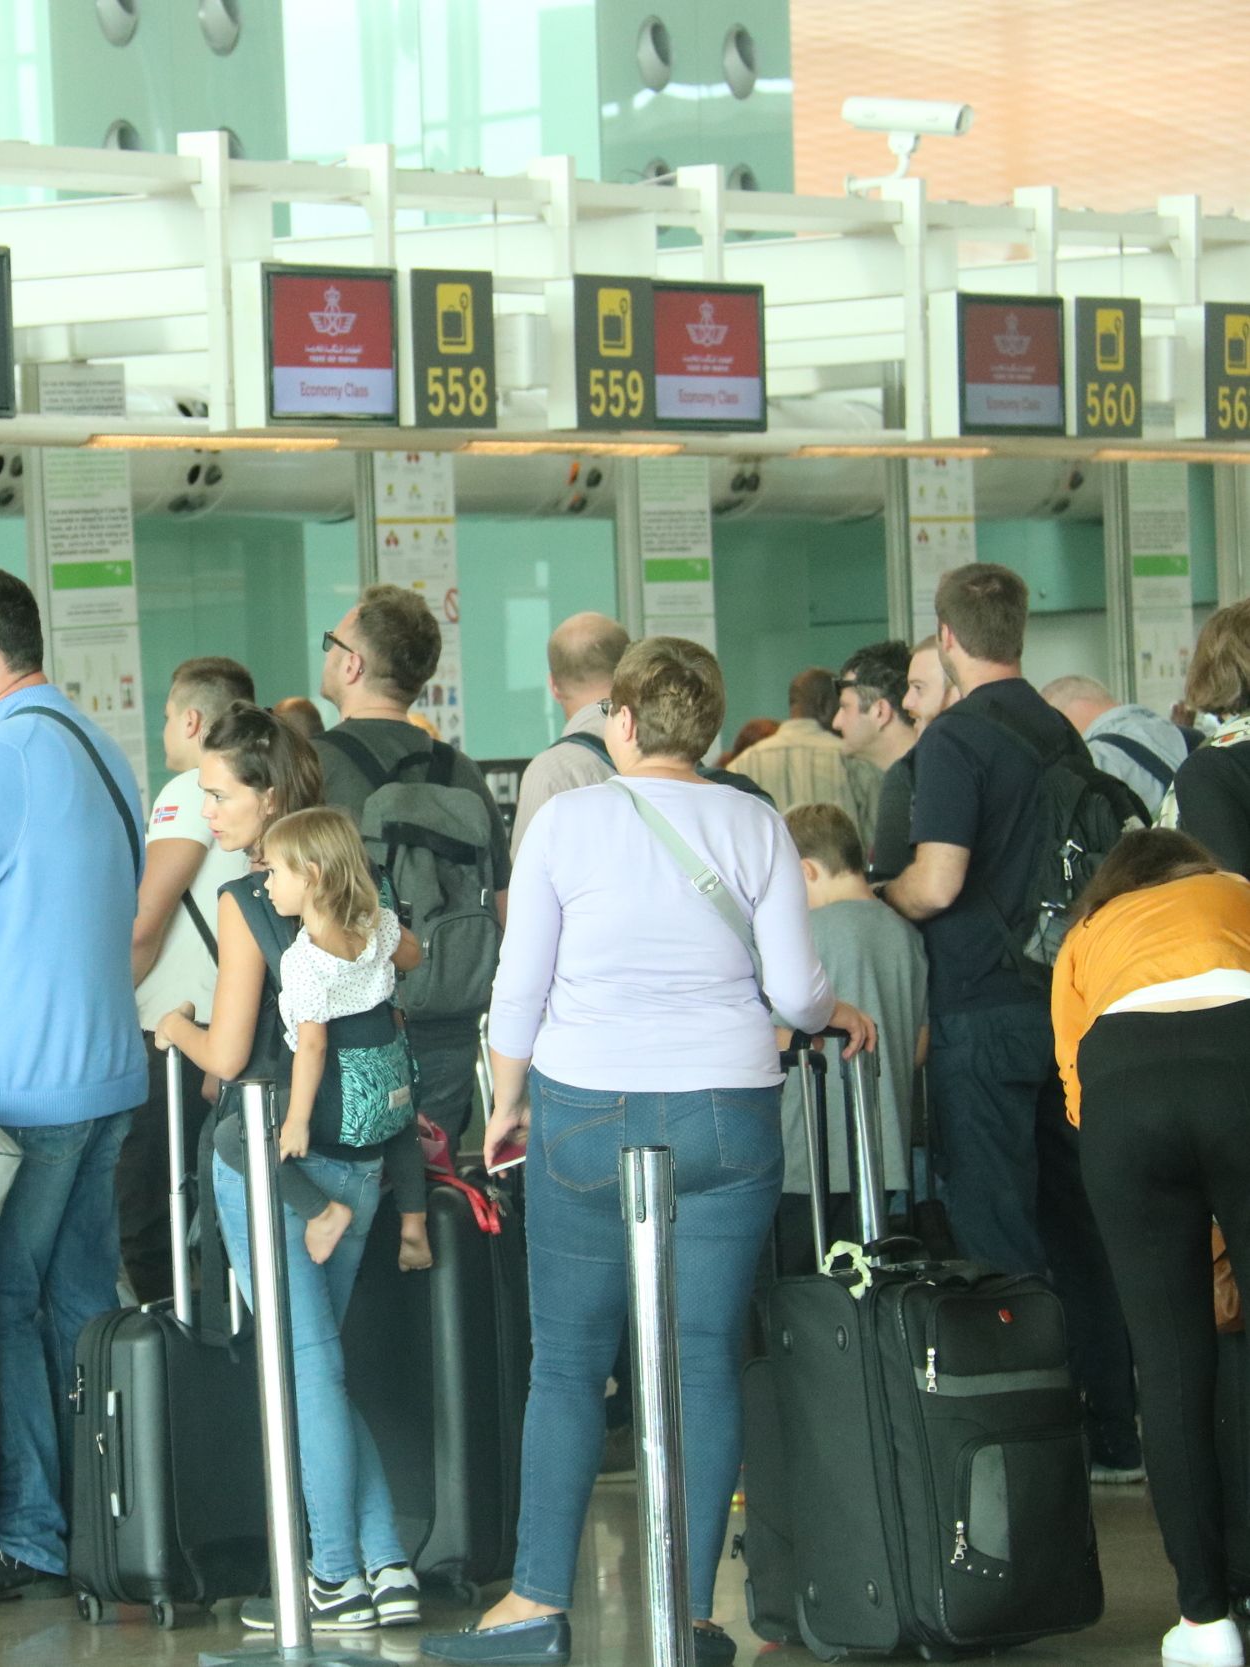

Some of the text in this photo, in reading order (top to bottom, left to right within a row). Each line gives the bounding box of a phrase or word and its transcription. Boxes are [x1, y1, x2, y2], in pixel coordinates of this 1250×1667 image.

[300, 381, 369, 400] Economy Class
[427, 367, 488, 417] 558
[589, 369, 644, 418] 559
[1086, 382, 1136, 427] 560
[1218, 386, 1250, 430] 56
